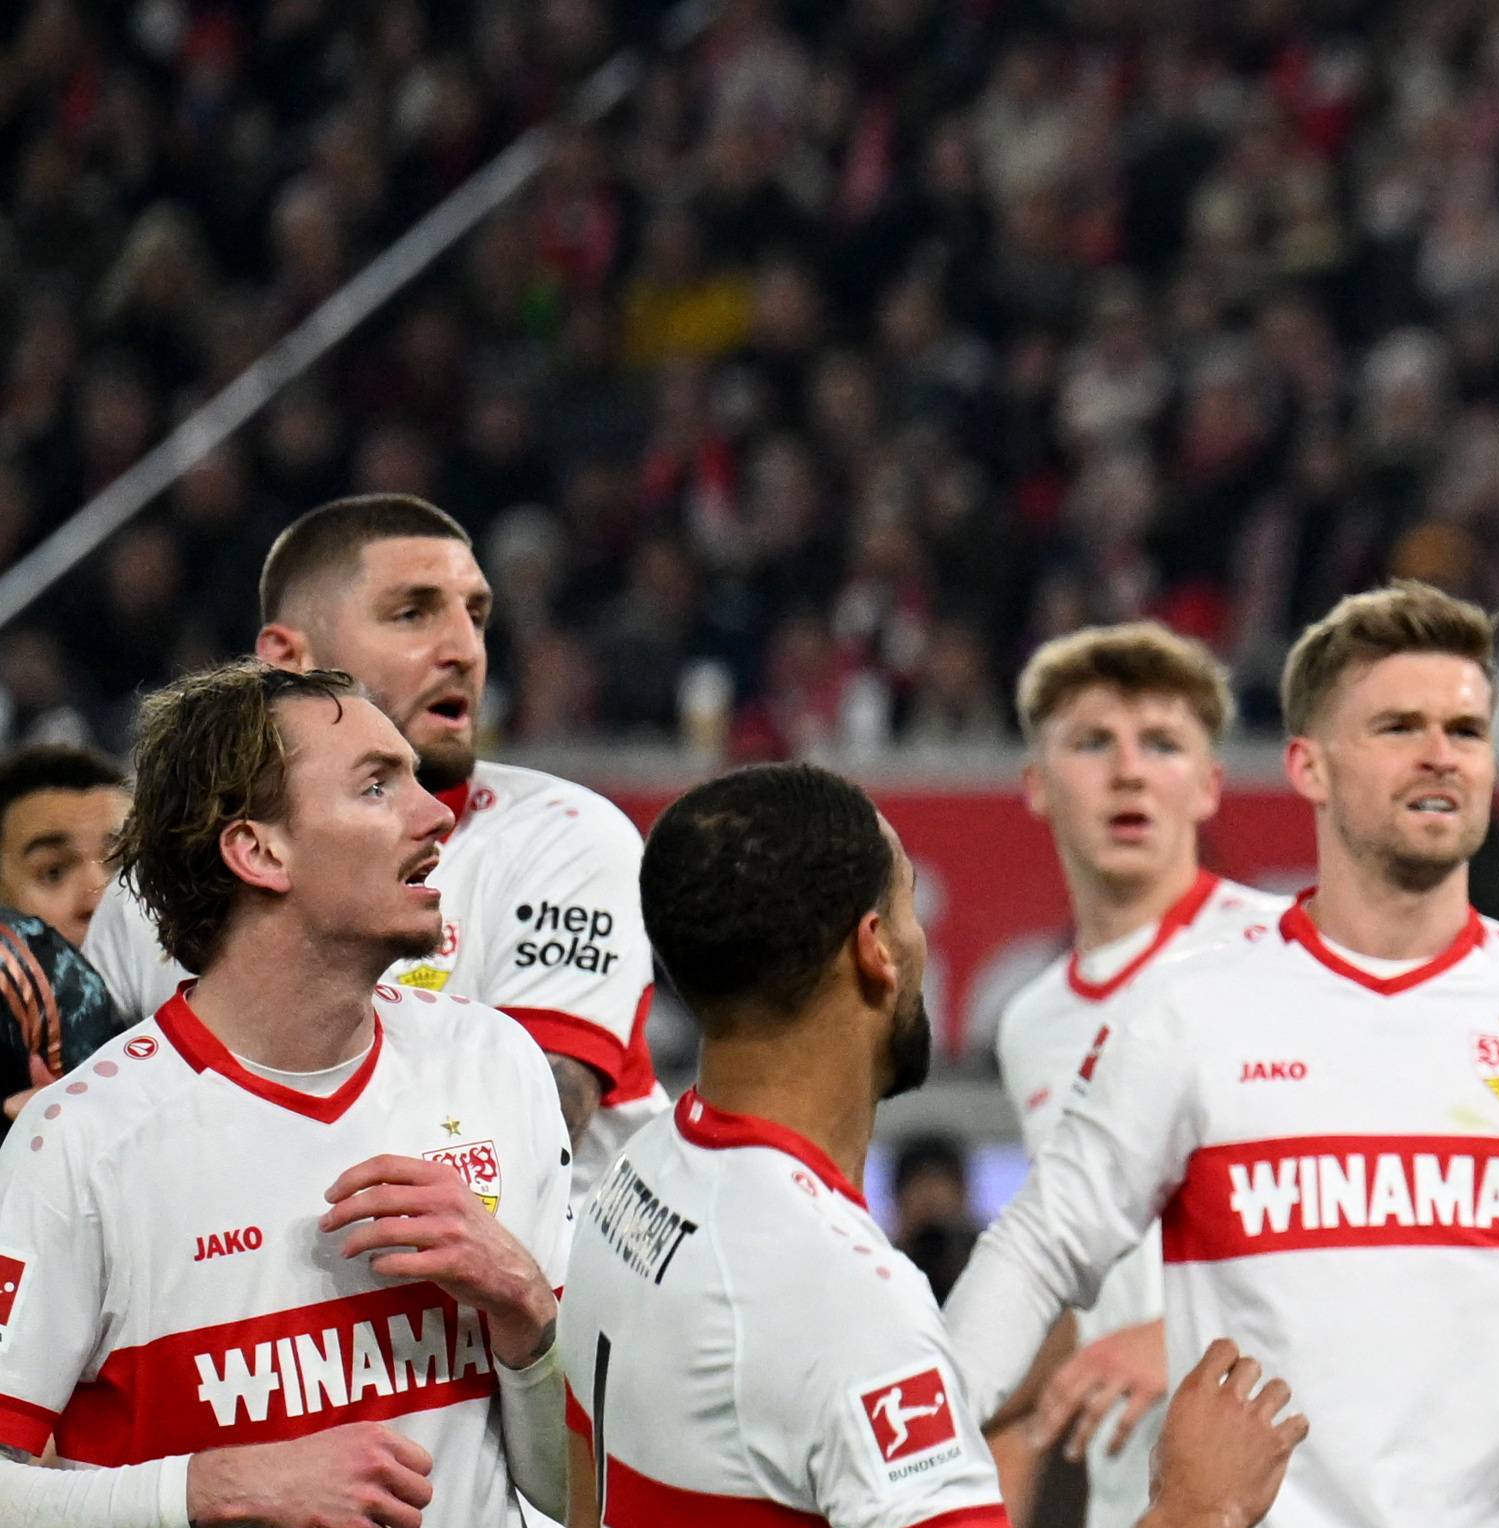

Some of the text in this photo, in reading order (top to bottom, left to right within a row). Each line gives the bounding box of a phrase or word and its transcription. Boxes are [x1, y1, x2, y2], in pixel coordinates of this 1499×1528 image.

[535, 901, 613, 942] hep
[515, 937, 618, 974] solar
[1239, 1061, 1308, 1083] JAKO
[194, 1226, 263, 1262] JAKO
[193, 1305, 491, 1427] WINAMA
